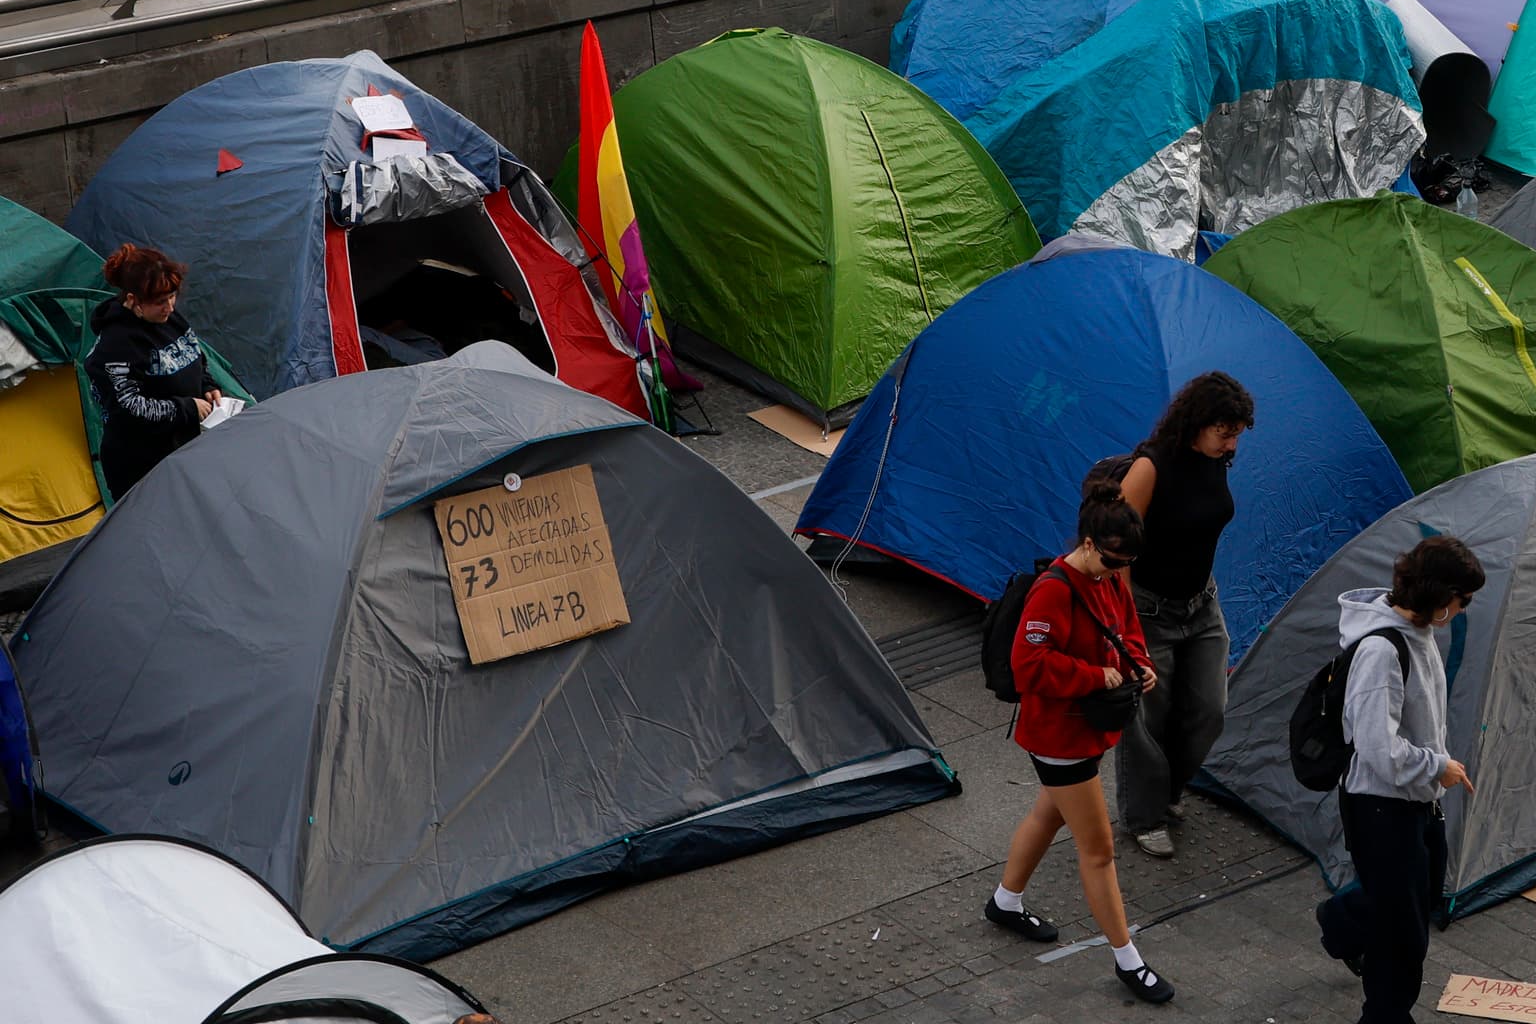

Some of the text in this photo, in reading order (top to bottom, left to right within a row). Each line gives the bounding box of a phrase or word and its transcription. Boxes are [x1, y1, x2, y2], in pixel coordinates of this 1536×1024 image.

[446, 492, 561, 547] 600 VIVIENDAS
[507, 512, 591, 549] AFECTADAS
[460, 540, 605, 598] 73 DEMOLIDAS
[497, 600, 549, 638] LINEA
[1445, 994, 1482, 1008] ES
